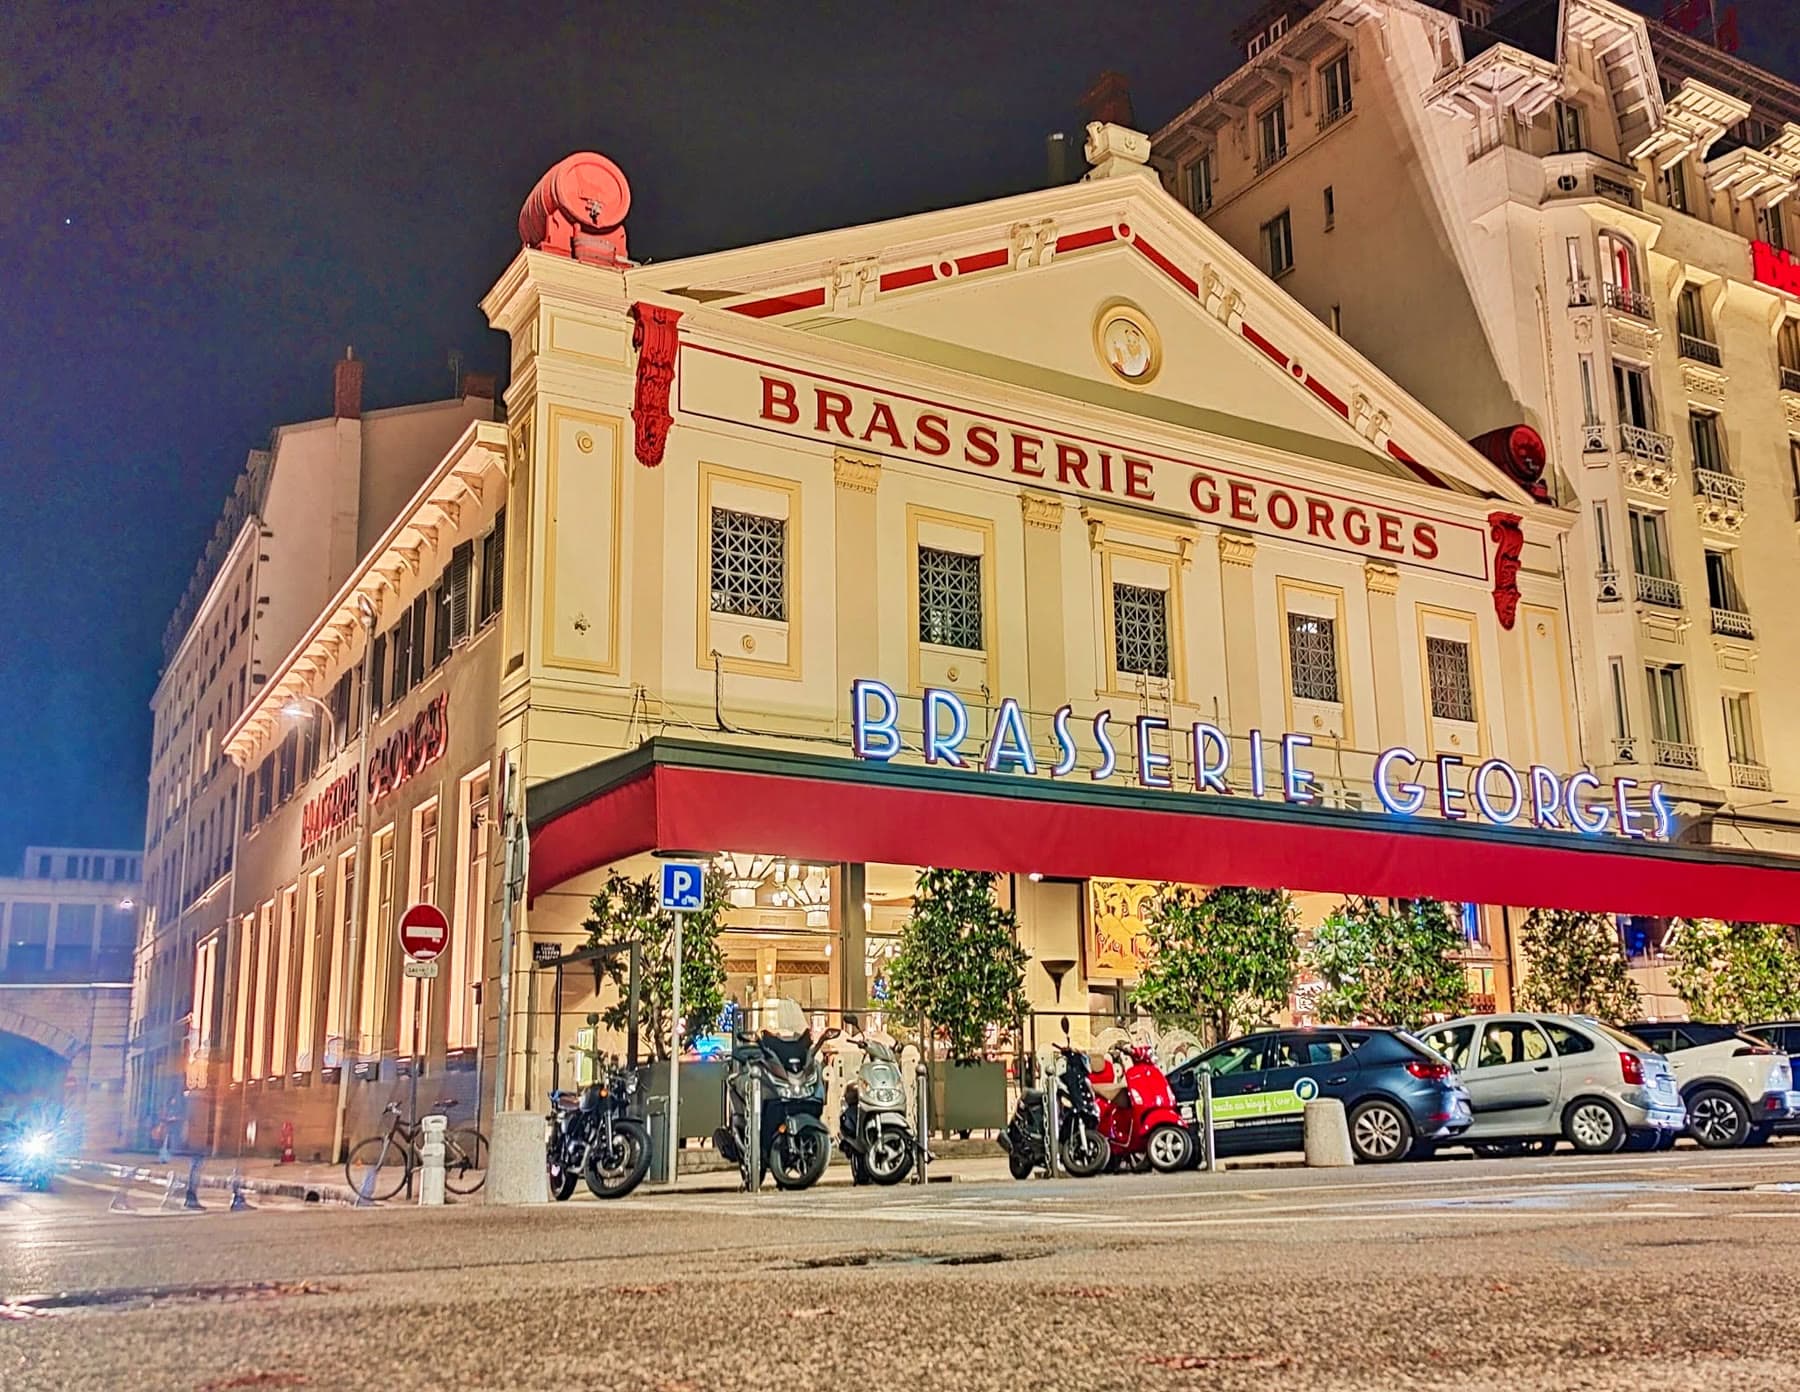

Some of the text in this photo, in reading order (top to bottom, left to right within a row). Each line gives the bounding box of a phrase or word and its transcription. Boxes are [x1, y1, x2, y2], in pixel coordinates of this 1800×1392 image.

[759, 375, 1439, 560] BRASSERIE GEORGES
[852, 678, 1671, 840] BRASSERIE GEORGES
[673, 870, 692, 899] P
